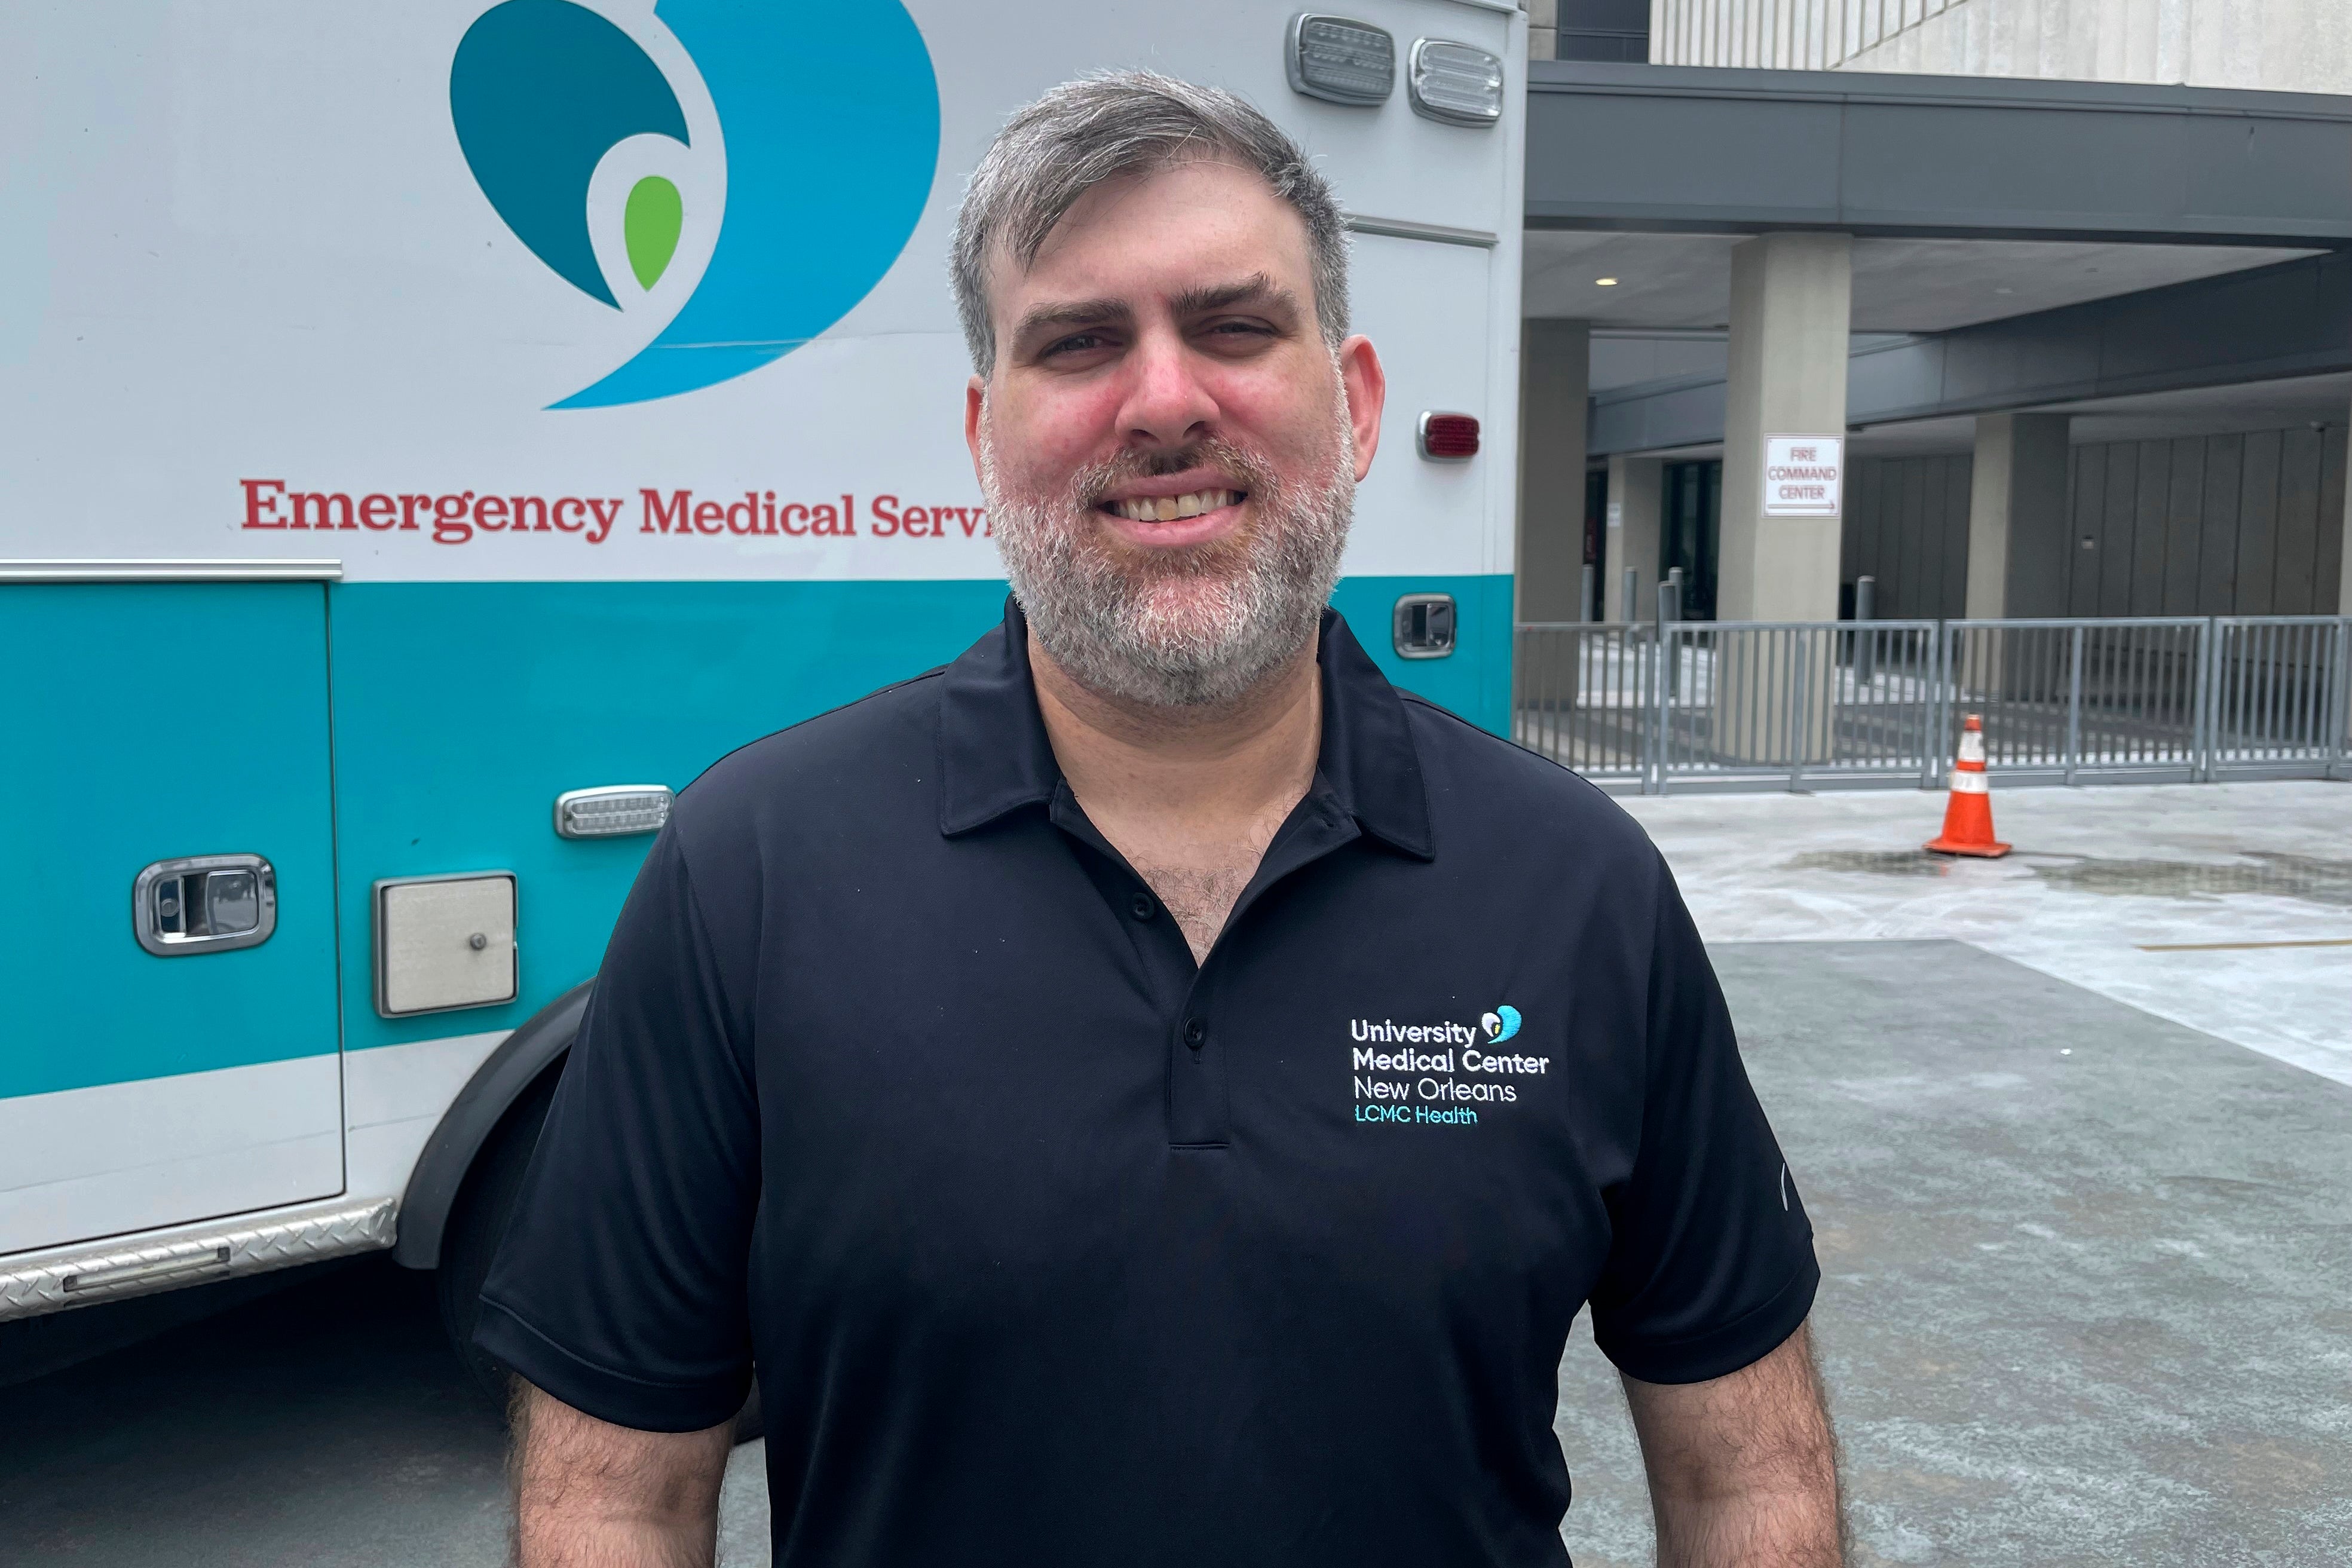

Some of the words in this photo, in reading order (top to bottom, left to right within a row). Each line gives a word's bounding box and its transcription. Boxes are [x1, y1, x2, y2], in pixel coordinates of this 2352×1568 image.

[1790, 447, 1817, 462] FIRE
[1768, 466, 1837, 481] COMMAND
[1778, 485, 1826, 500] CENTER
[240, 479, 623, 545] Emergency
[640, 489, 856, 537] Medical
[1351, 1019, 1477, 1048] University
[1353, 1048, 1455, 1073] Medical
[1462, 1048, 1549, 1074] Center
[1354, 1076, 1410, 1101] New
[1418, 1077, 1517, 1102] Orleans
[1355, 1104, 1411, 1123] LCMC
[1416, 1105, 1478, 1125] Health
